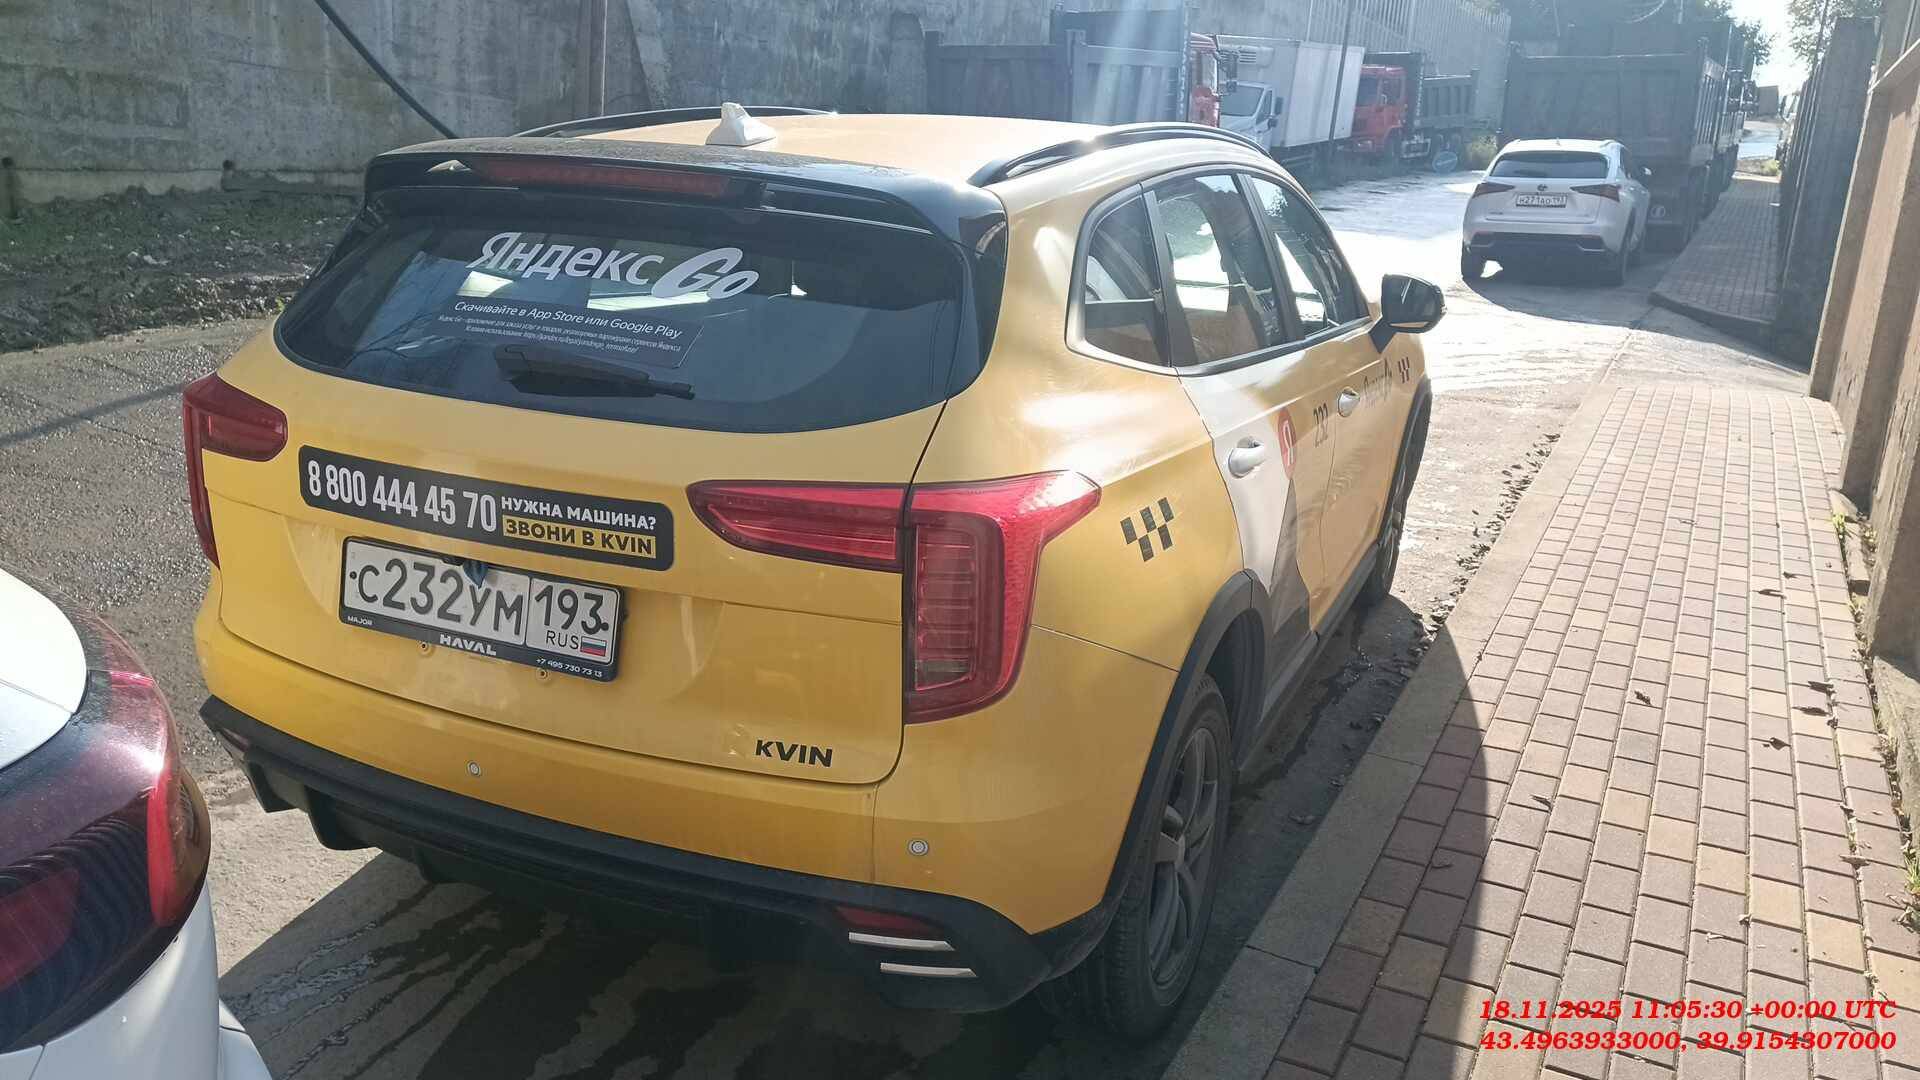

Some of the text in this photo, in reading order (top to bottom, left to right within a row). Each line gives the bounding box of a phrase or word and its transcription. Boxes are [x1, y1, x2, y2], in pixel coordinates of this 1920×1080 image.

[466, 231, 760, 300] Яндекс Go
[454, 301, 518, 316] Скачивайте
[518, 309, 527, 317] в
[527, 308, 552, 321] App
[552, 310, 584, 324] Store
[585, 316, 610, 327] или
[610, 318, 654, 334] Google
[654, 324, 683, 340] Play
[307, 459, 498, 533] 8 800 444 45 70
[501, 495, 658, 532] НУЖНА МАШИНА?
[505, 518, 654, 556] ЗВОНИ В KVIN
[356, 556, 607, 637] С232УМ 193
[439, 632, 498, 657] HAVAL
[545, 629, 580, 652] RUS
[535, 657, 546, 666] +7
[564, 661, 581, 673] 730
[581, 666, 594, 675] 73
[755, 738, 833, 768] KVIN
